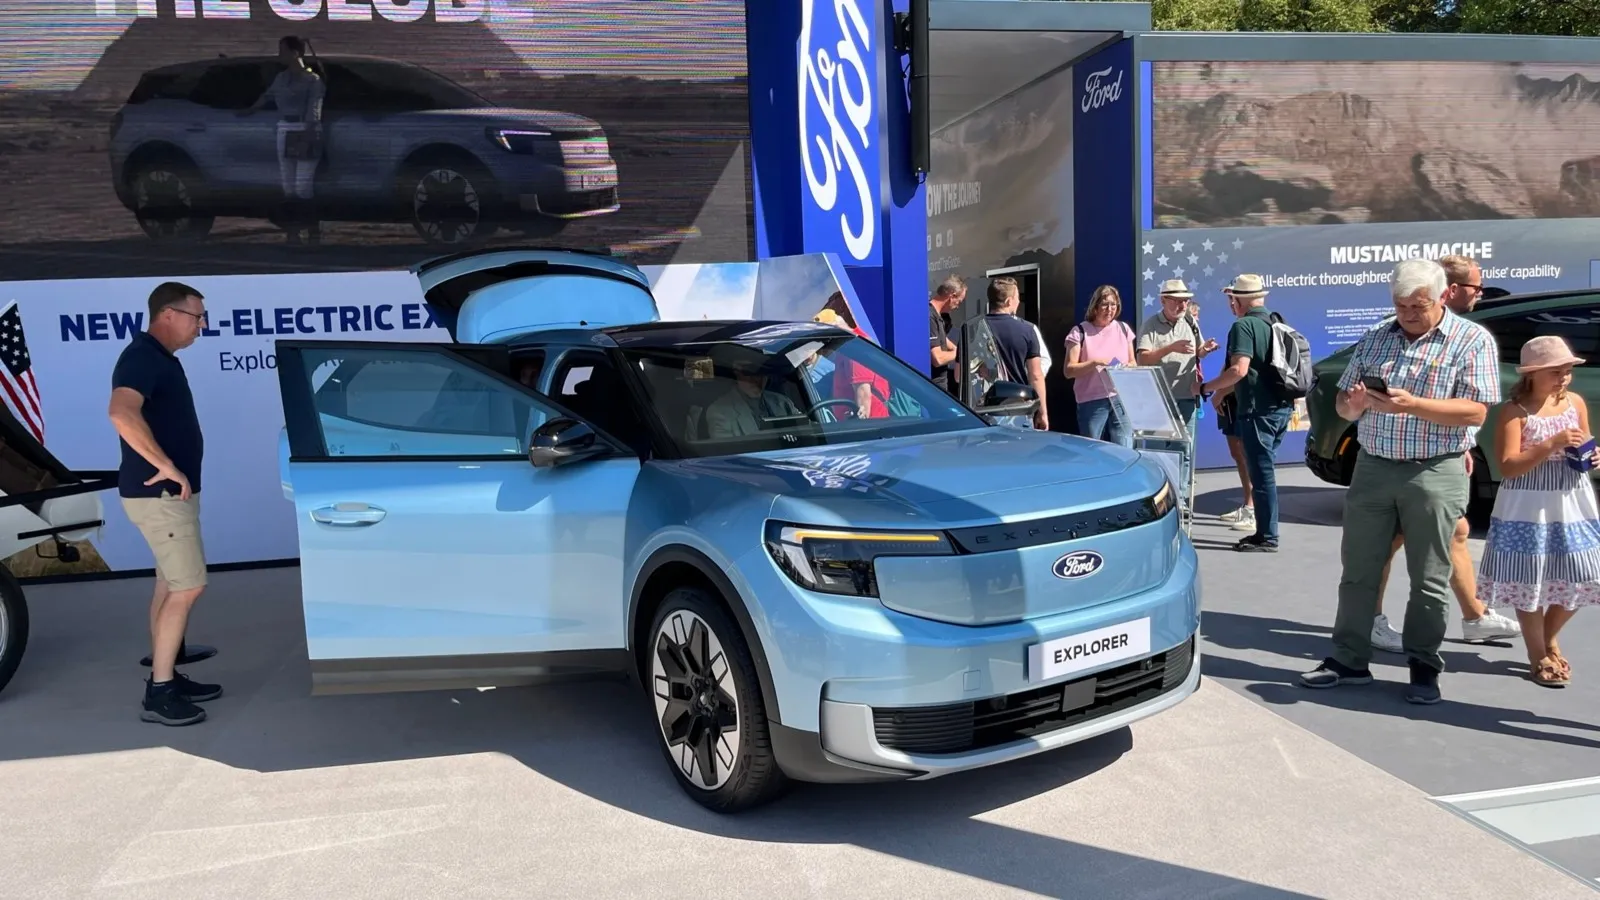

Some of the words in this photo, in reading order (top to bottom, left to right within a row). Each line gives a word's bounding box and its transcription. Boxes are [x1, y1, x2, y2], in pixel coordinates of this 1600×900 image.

[1081, 66, 1123, 113] Ford
[942, 182, 958, 213] THE
[958, 181, 981, 208] JOURNEY
[1330, 244, 1420, 264] MUSTANG
[1422, 241, 1492, 260] MACH-E
[1260, 273, 1318, 288] All-electric
[1510, 264, 1561, 281] capability
[59, 311, 144, 342] NEW
[1063, 554, 1095, 576] Ford
[1053, 632, 1129, 664] EXPLORER
